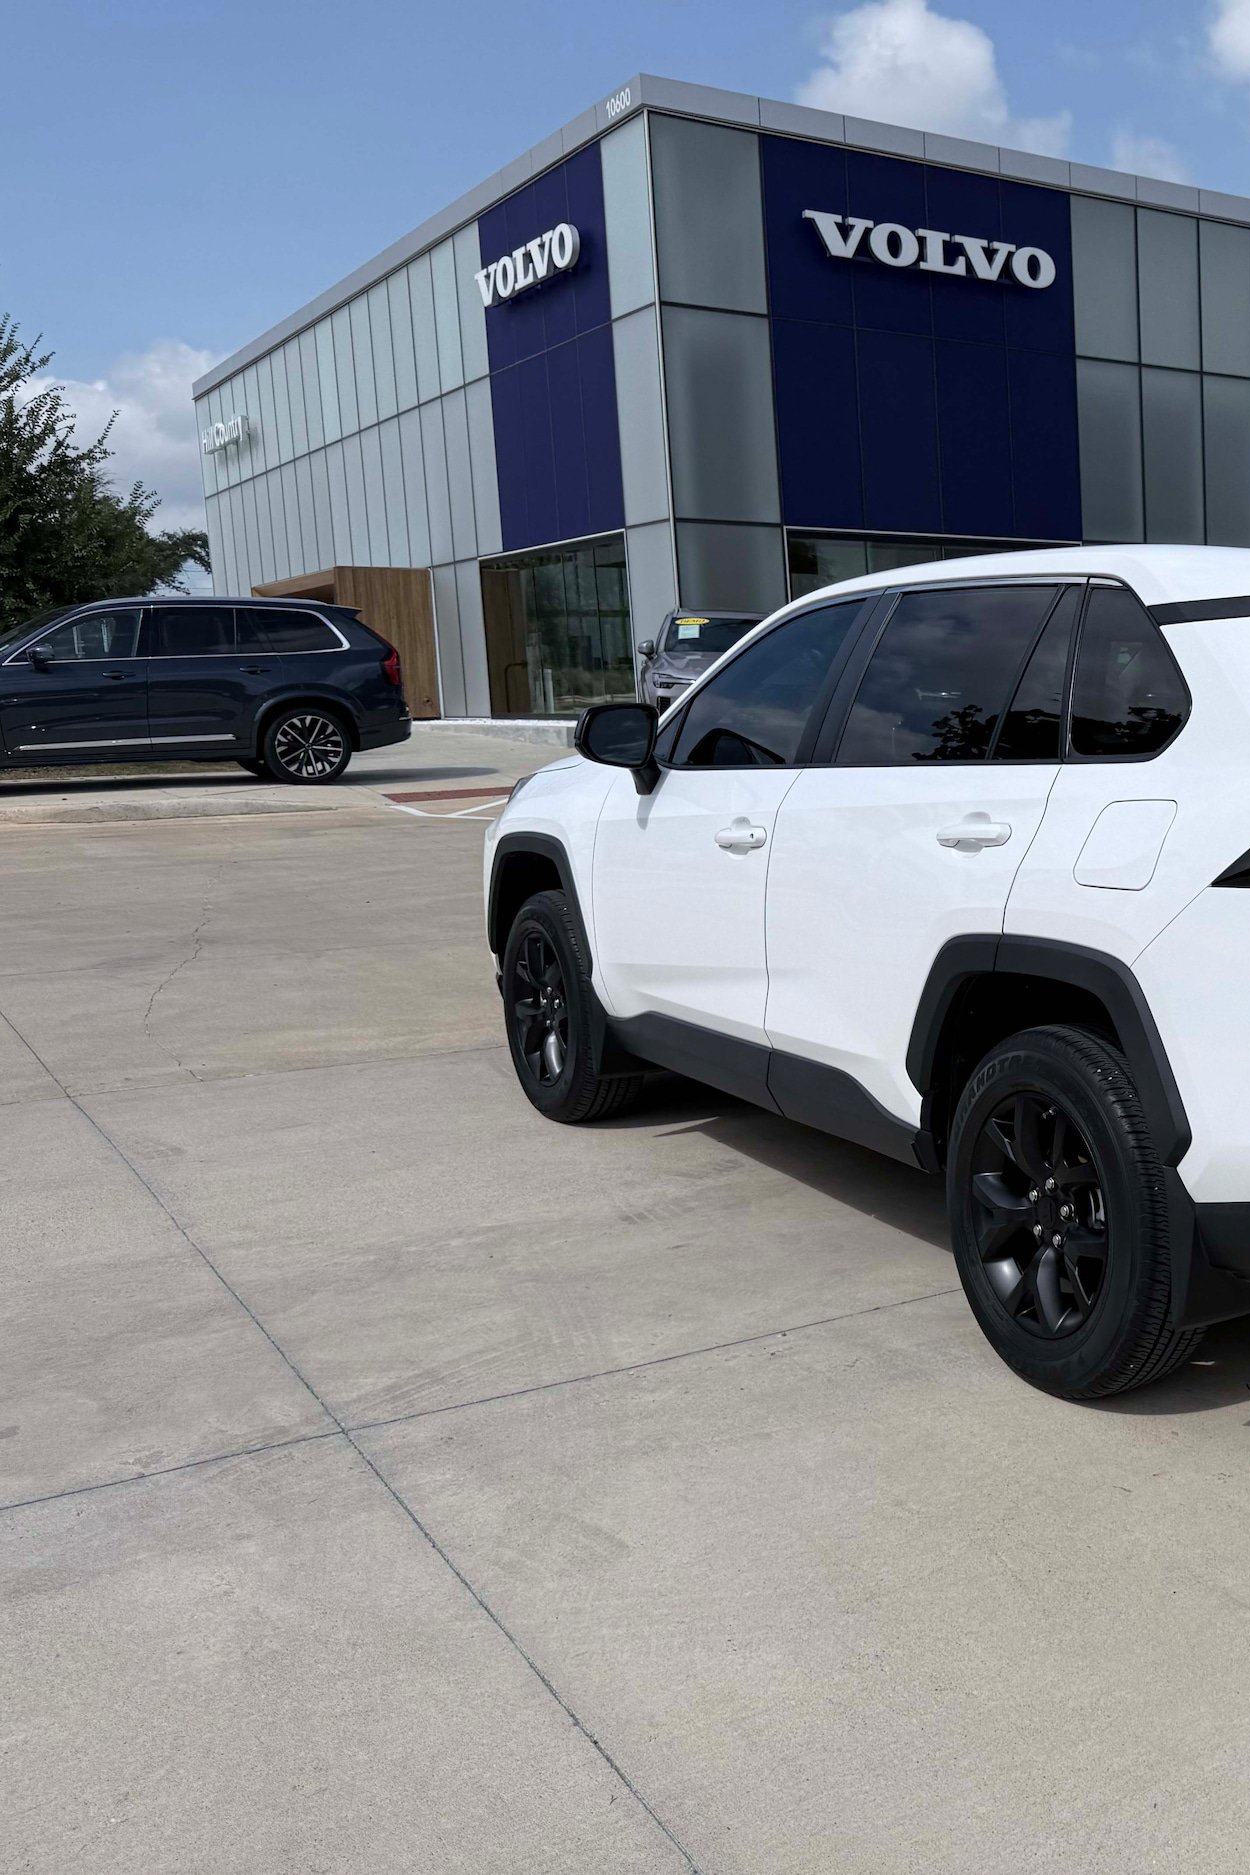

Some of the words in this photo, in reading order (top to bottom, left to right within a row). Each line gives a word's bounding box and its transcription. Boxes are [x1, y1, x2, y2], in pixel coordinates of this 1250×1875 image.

[606, 87, 630, 119] 10600
[474, 223, 579, 307] VOLVO
[802, 209, 1056, 289] VOLVO
[202, 427, 214, 454] Hill
[214, 415, 242, 446] Country
